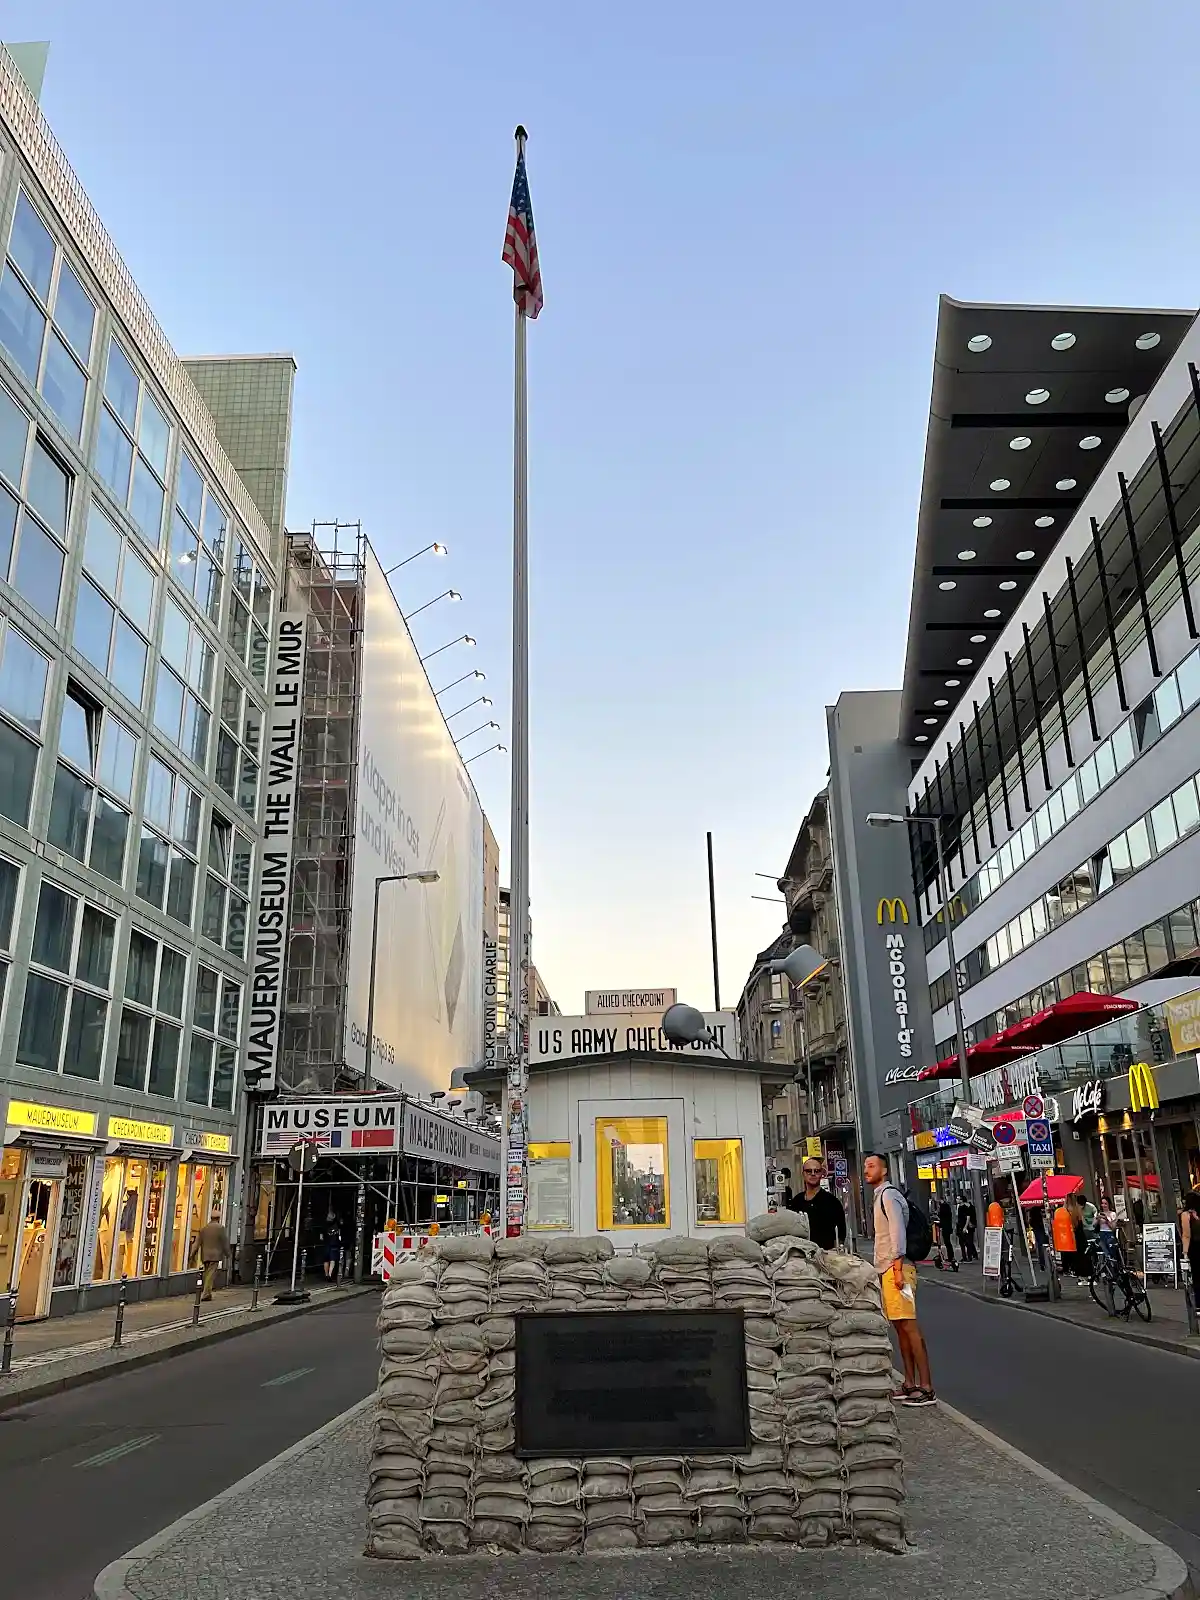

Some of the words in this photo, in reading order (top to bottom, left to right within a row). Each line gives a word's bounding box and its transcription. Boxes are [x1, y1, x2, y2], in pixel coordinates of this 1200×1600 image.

[276, 620, 303, 675] MUR
[274, 683, 299, 706] LE
[268, 718, 296, 786] WALL
[264, 794, 291, 839] THE
[362, 745, 396, 822] Klappt
[398, 795, 405, 836] in
[406, 815, 420, 858] Ost
[361, 803, 382, 856] und
[248, 852, 288, 1079] MAUERMUSEUM
[485, 940, 497, 996] CHARLIE
[597, 994, 620, 1008] ALLIED
[622, 992, 665, 1007] CHECKPOINT
[886, 933, 915, 1058] McDonald's
[538, 1029, 562, 1054] US
[571, 1027, 618, 1054] ARMY
[626, 1025, 726, 1051] CHECNT
[885, 1065, 928, 1086] McCaf
[977, 1070, 1005, 1109] SNACKS
[1011, 1056, 1041, 1100] COFFEE
[27, 1107, 79, 1129] MAUERMUSEUM
[267, 1106, 396, 1129] MUSEUM
[1072, 1080, 1102, 1119] McCafé
[113, 1121, 146, 1139] CHECKPOINT
[146, 1126, 167, 1142] CHARLIE
[185, 1132, 210, 1147] CHECKPOINT
[409, 1113, 467, 1158] MAUERMUSEUM
[1030, 1143, 1051, 1152] TAXI
